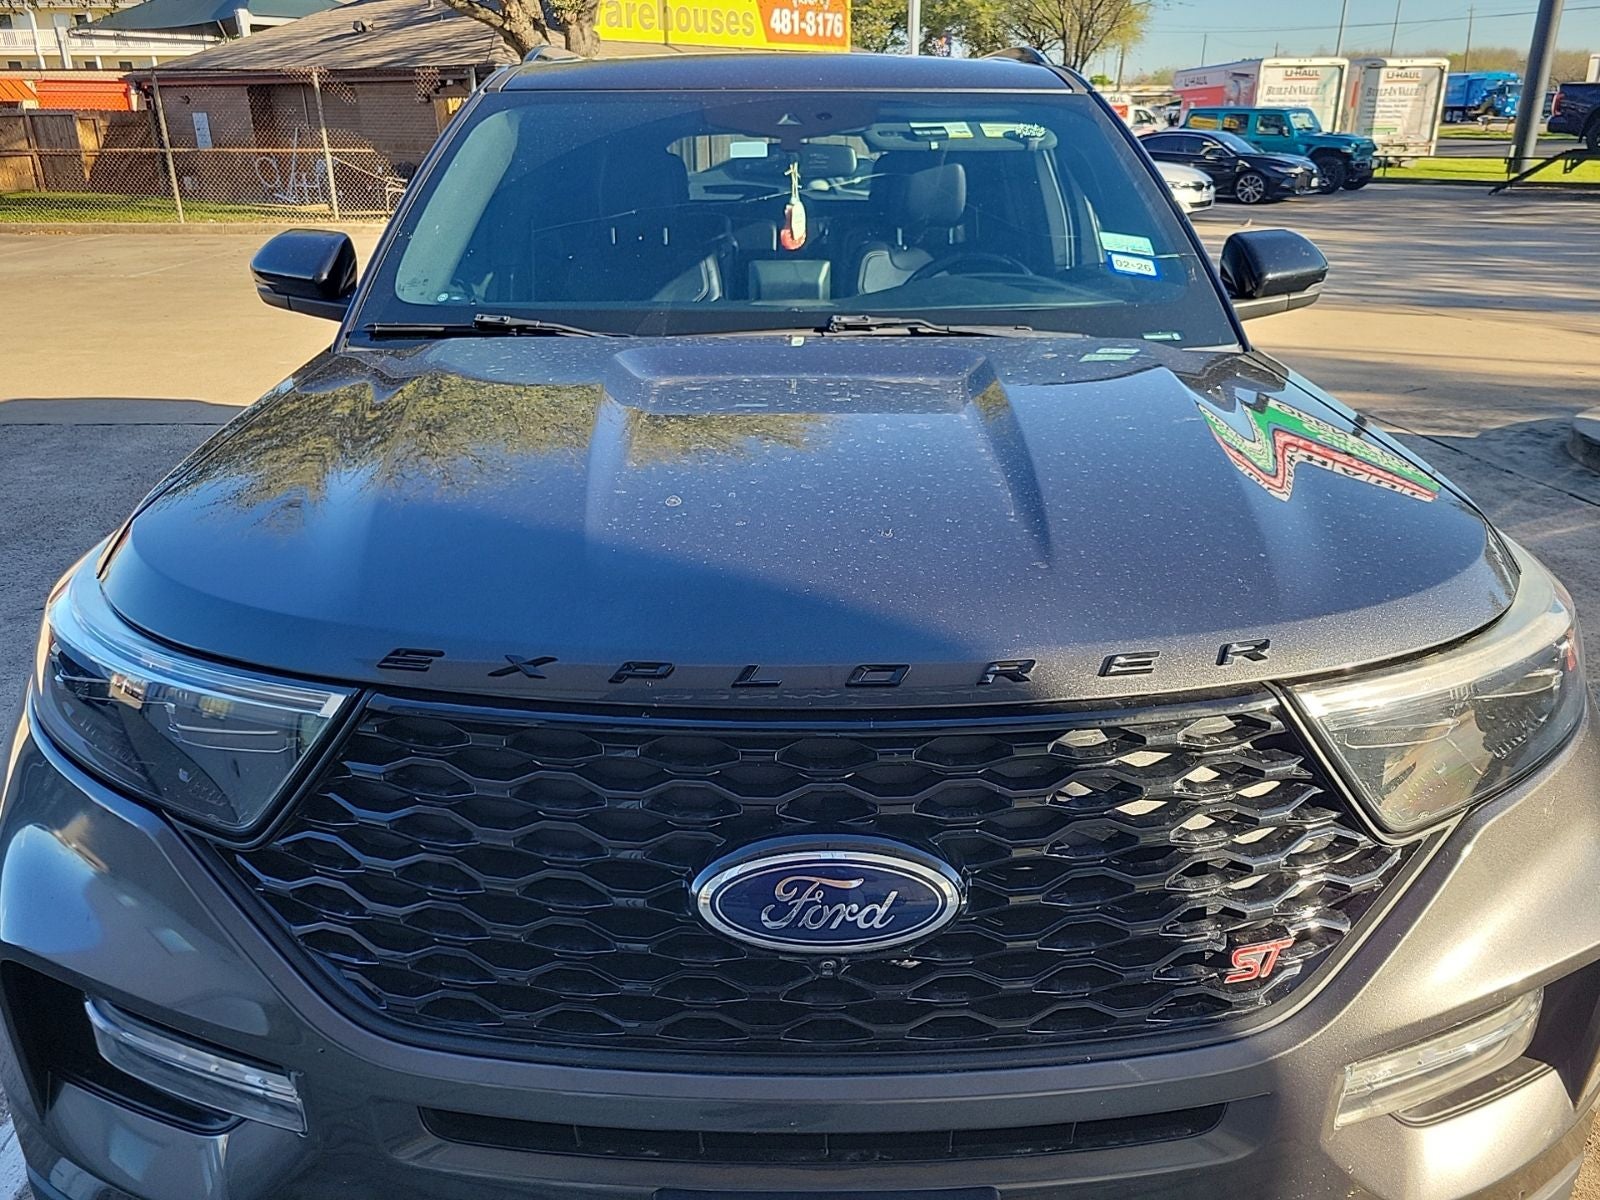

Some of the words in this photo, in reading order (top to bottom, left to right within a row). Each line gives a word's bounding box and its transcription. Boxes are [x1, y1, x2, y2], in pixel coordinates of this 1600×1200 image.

[770, 8, 843, 38] 481-8176
[1115, 259, 1152, 272] 02-26
[376, 638, 1271, 688] EXPLORER
[761, 875, 898, 930] Ford
[1224, 937, 1294, 984] ST
